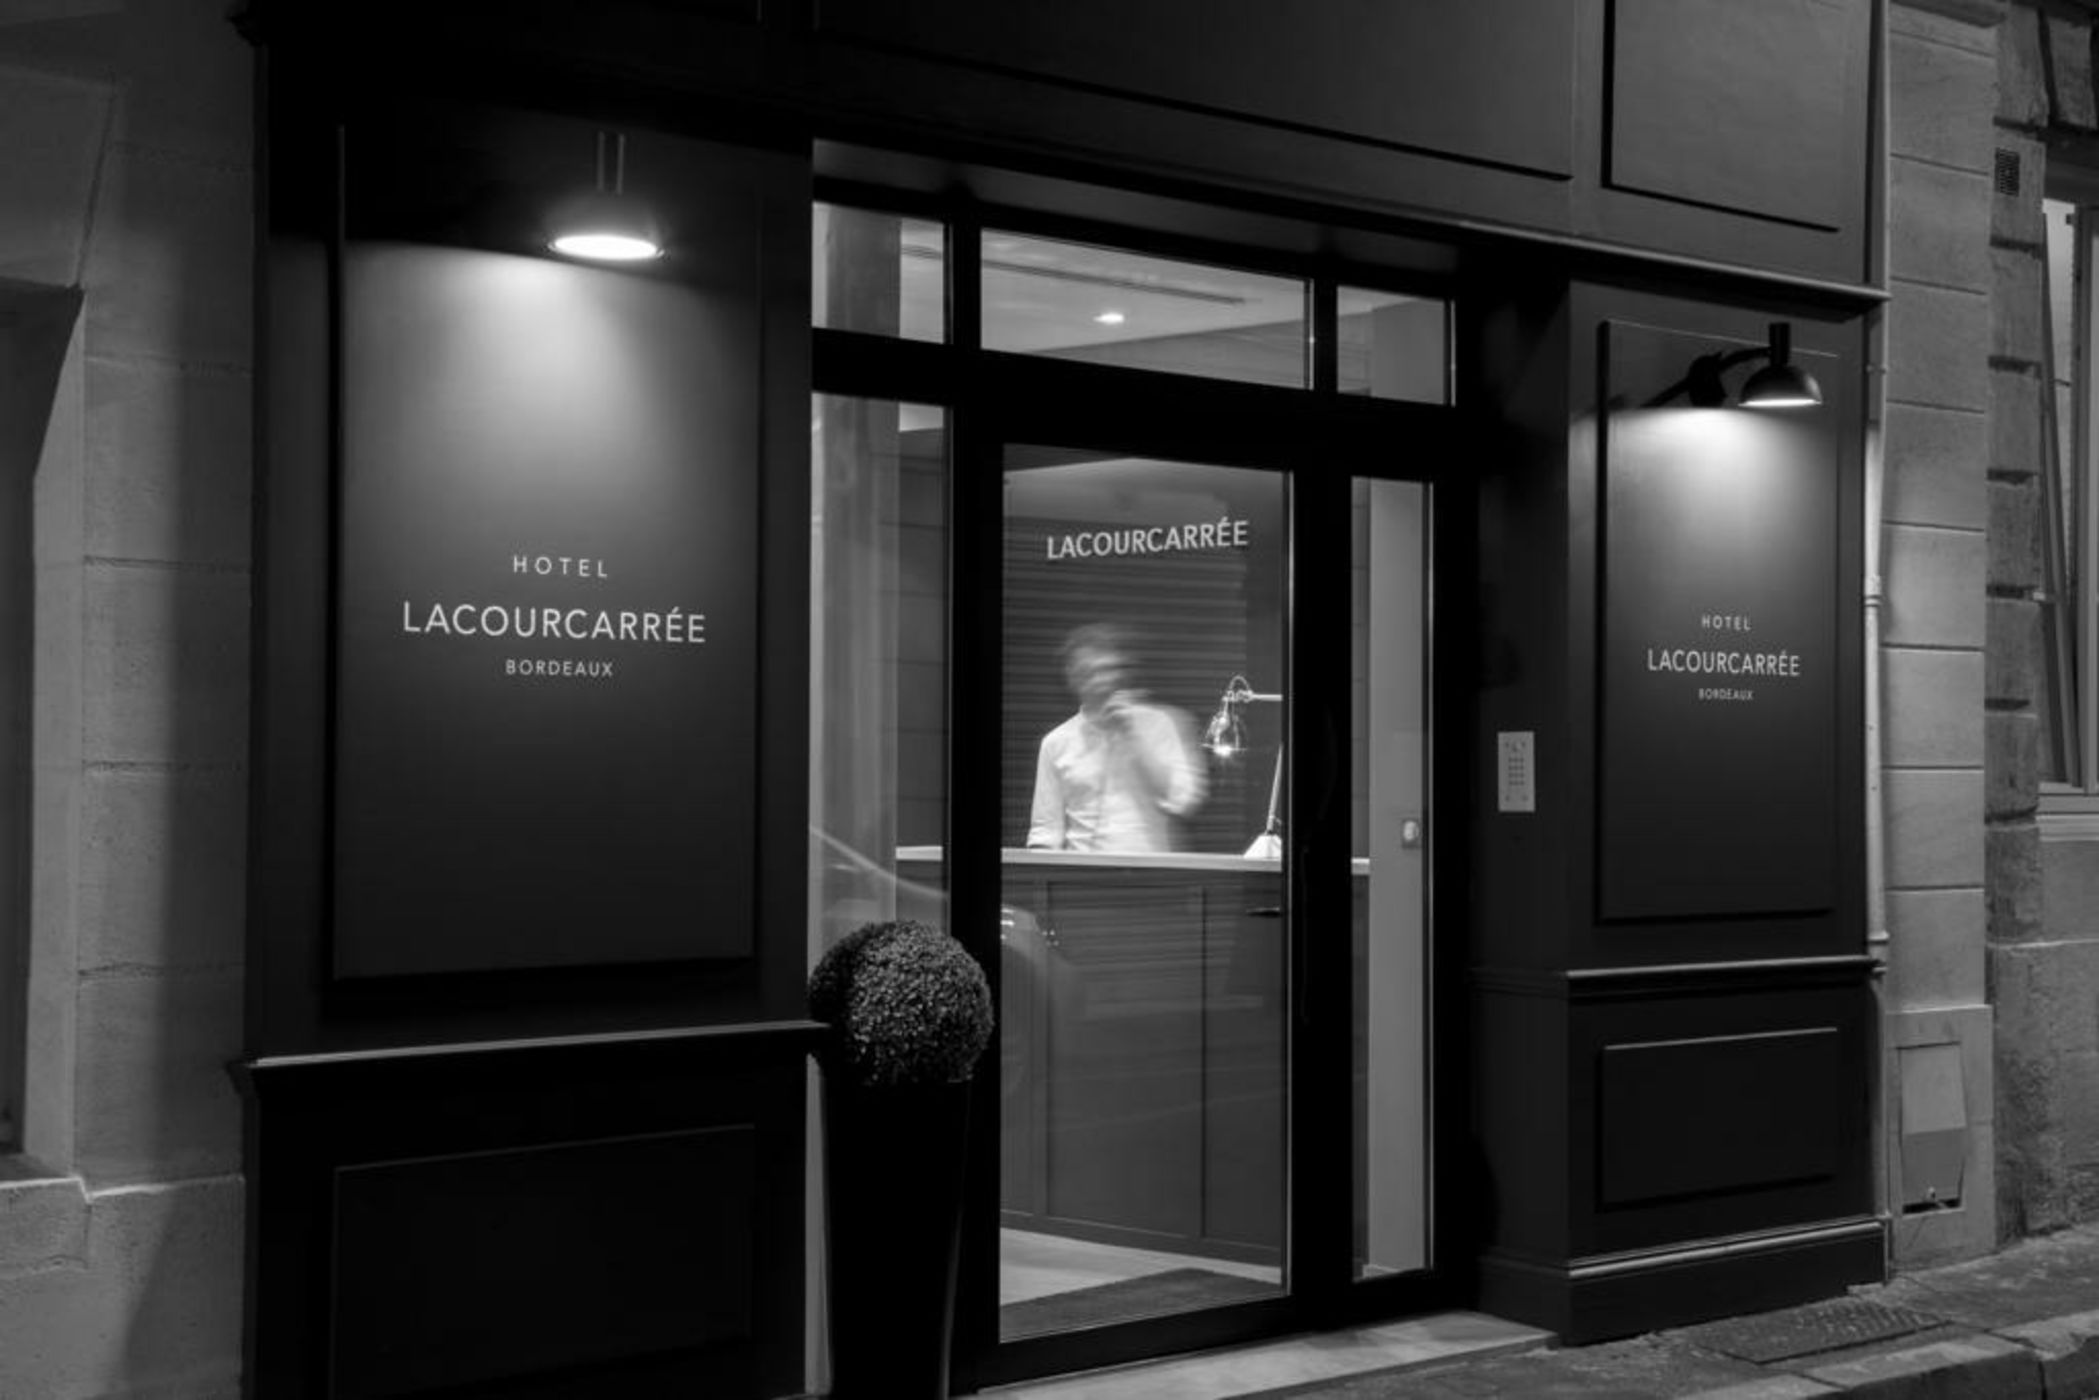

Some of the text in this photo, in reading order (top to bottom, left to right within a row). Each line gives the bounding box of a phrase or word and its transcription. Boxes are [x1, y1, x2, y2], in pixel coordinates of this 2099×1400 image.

[1046, 515, 1249, 560] LACOURCARRÉE
[512, 554, 608, 578] HOTEL
[402, 600, 706, 643] LACOURCARRÉE
[1701, 614, 1751, 632] HOTEL
[505, 658, 614, 678] BORDEAUX
[1647, 648, 1800, 677] LACOURCARRÉE
[1698, 687, 1754, 701] BORDEAUX
